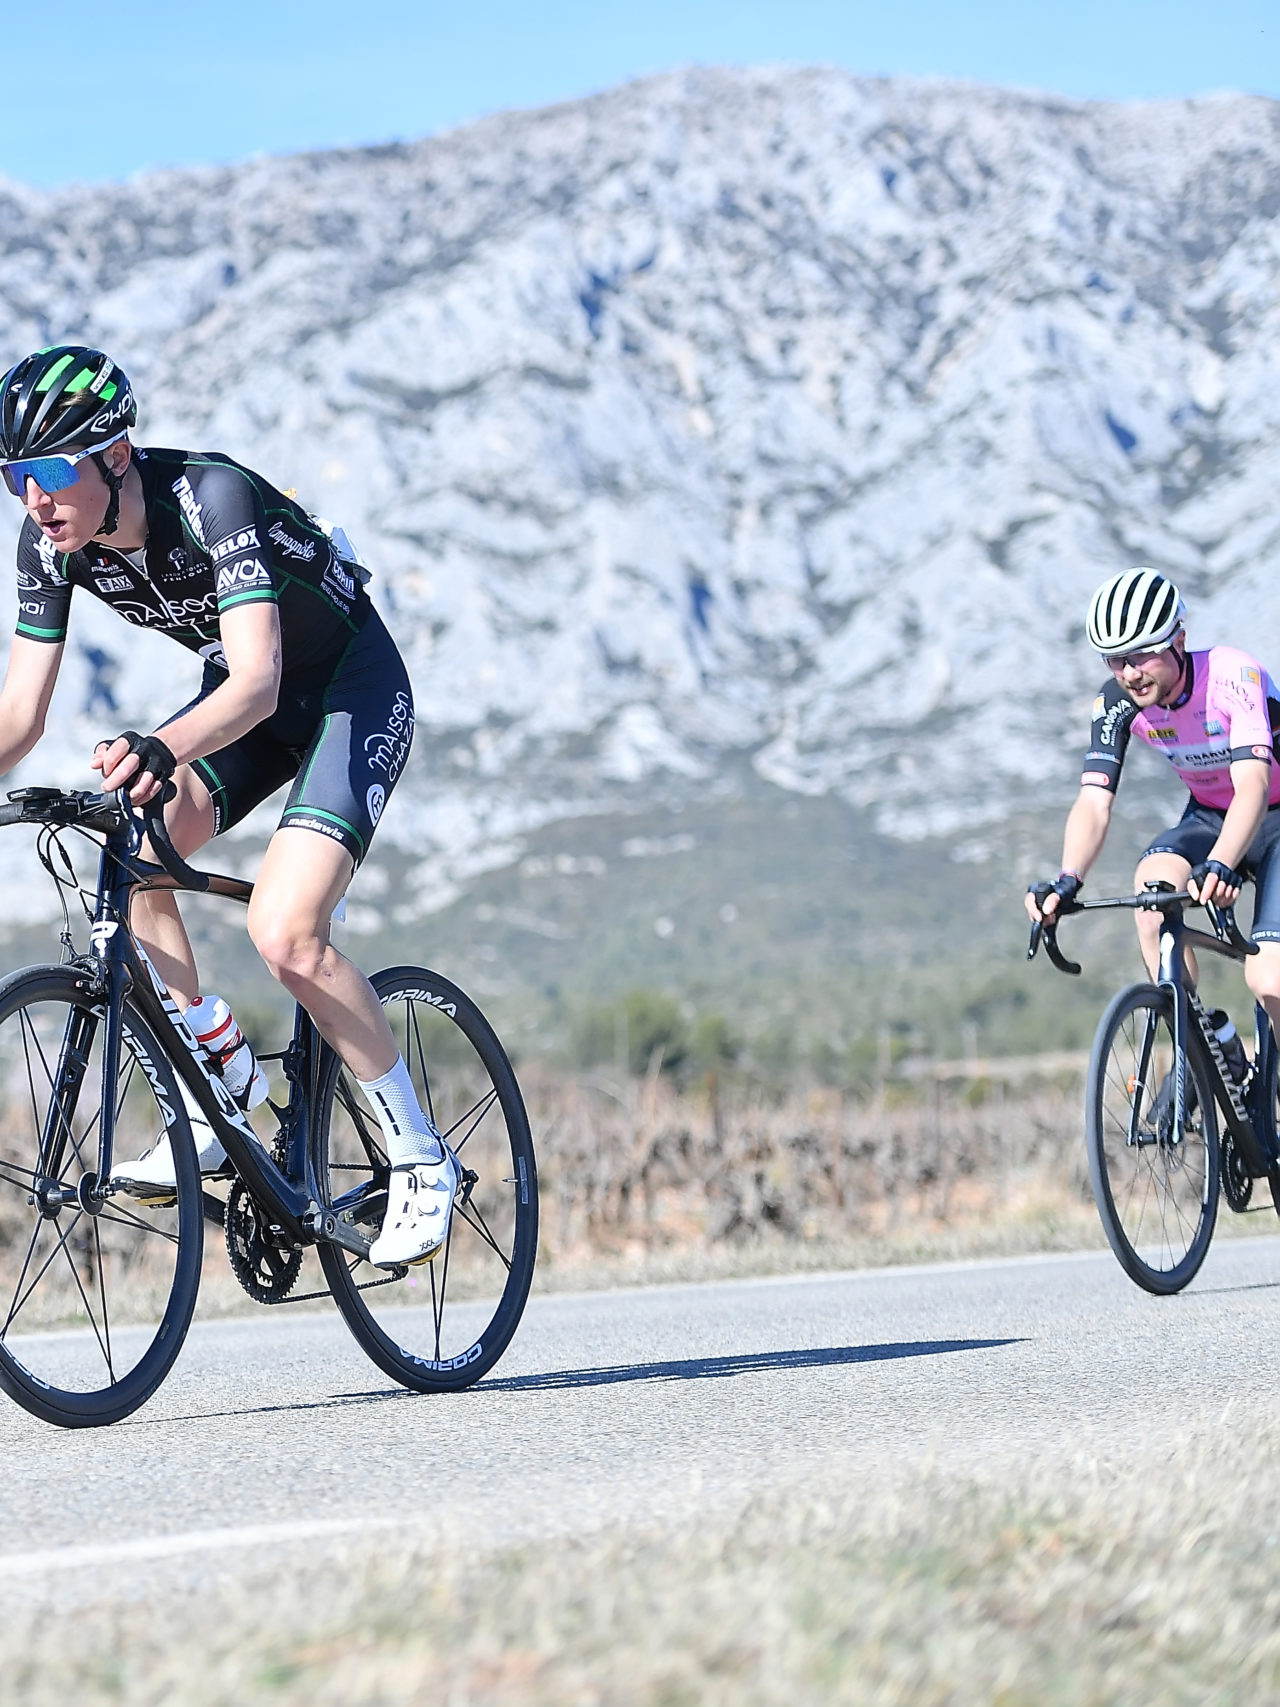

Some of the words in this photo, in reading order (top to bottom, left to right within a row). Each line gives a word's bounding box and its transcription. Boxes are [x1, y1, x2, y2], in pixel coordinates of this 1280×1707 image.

[388, 708, 415, 783] CHAZA
[287, 817, 345, 841] madewis
[132, 934, 262, 1146] RIDLEY
